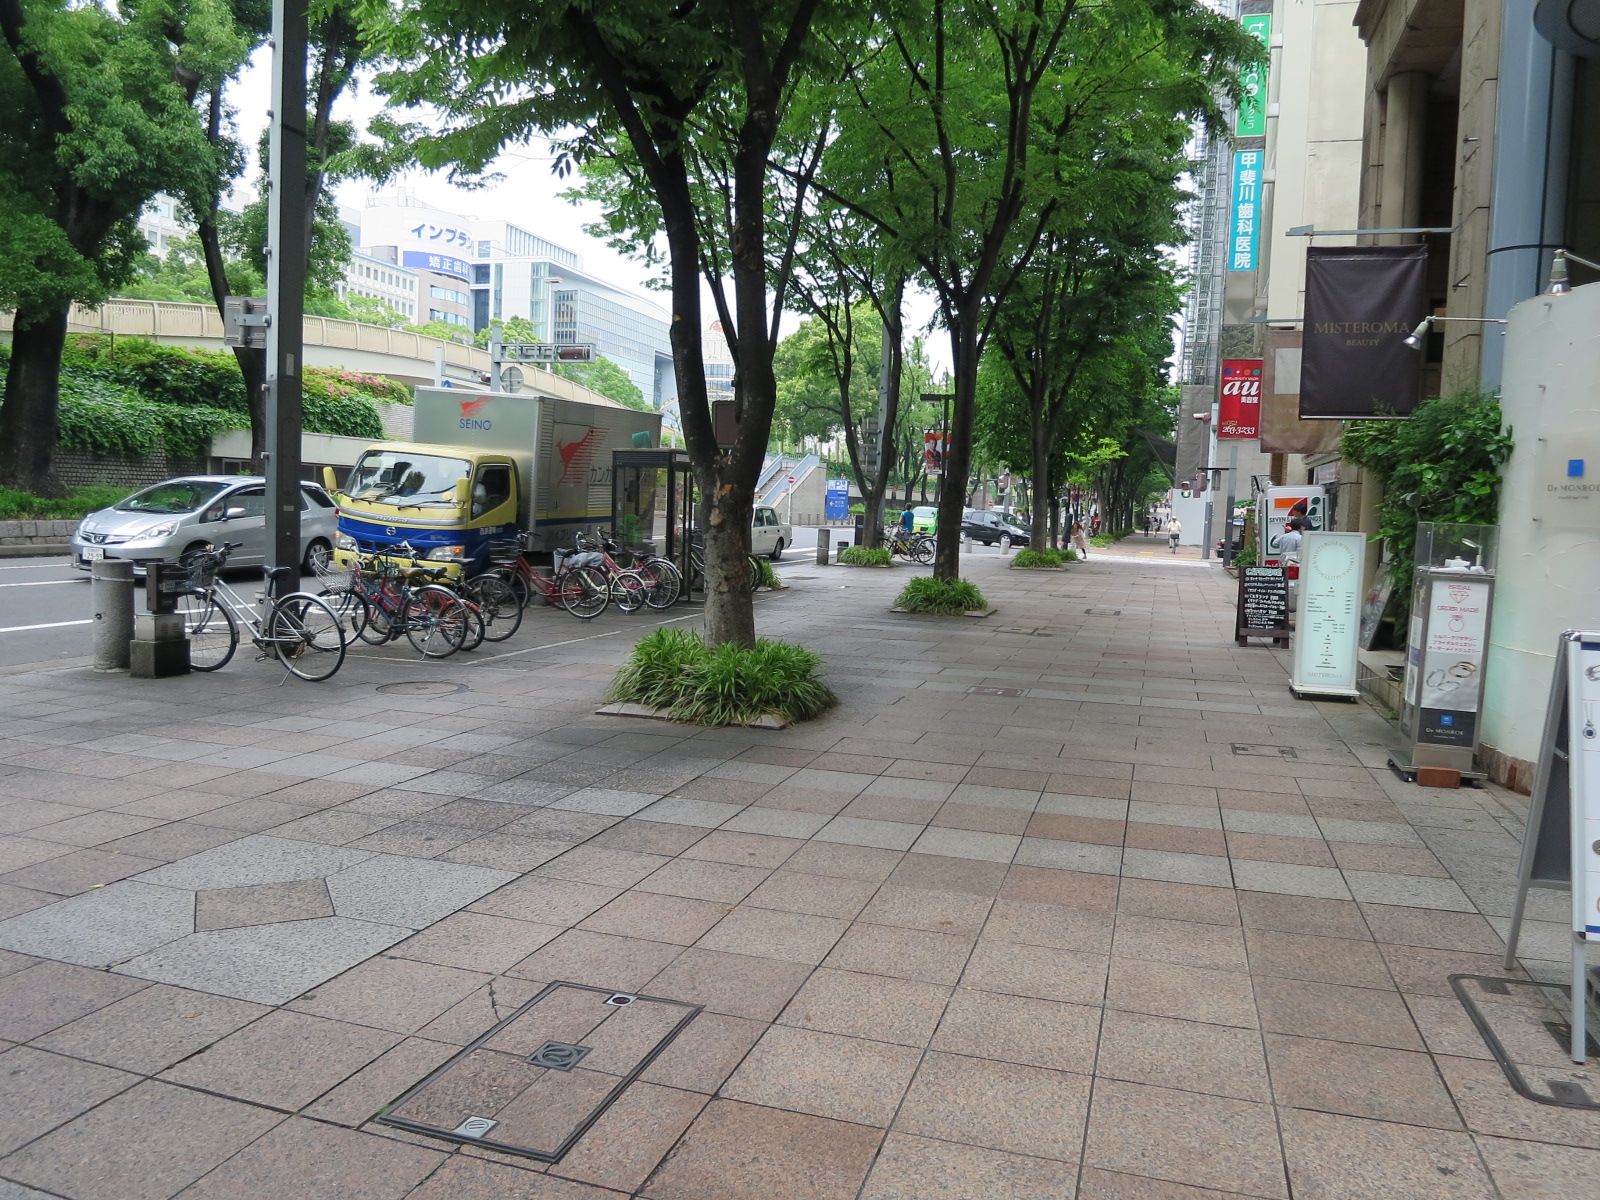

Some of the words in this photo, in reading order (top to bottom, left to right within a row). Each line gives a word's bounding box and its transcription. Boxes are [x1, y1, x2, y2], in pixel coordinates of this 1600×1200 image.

[1234, 152, 1257, 269] 甲斐川歯科医院
[1313, 321, 1409, 334] MISTEROMA
[1345, 338, 1380, 346] BEAUTY
[1223, 381, 1260, 396] au
[459, 418, 492, 431] SEINO
